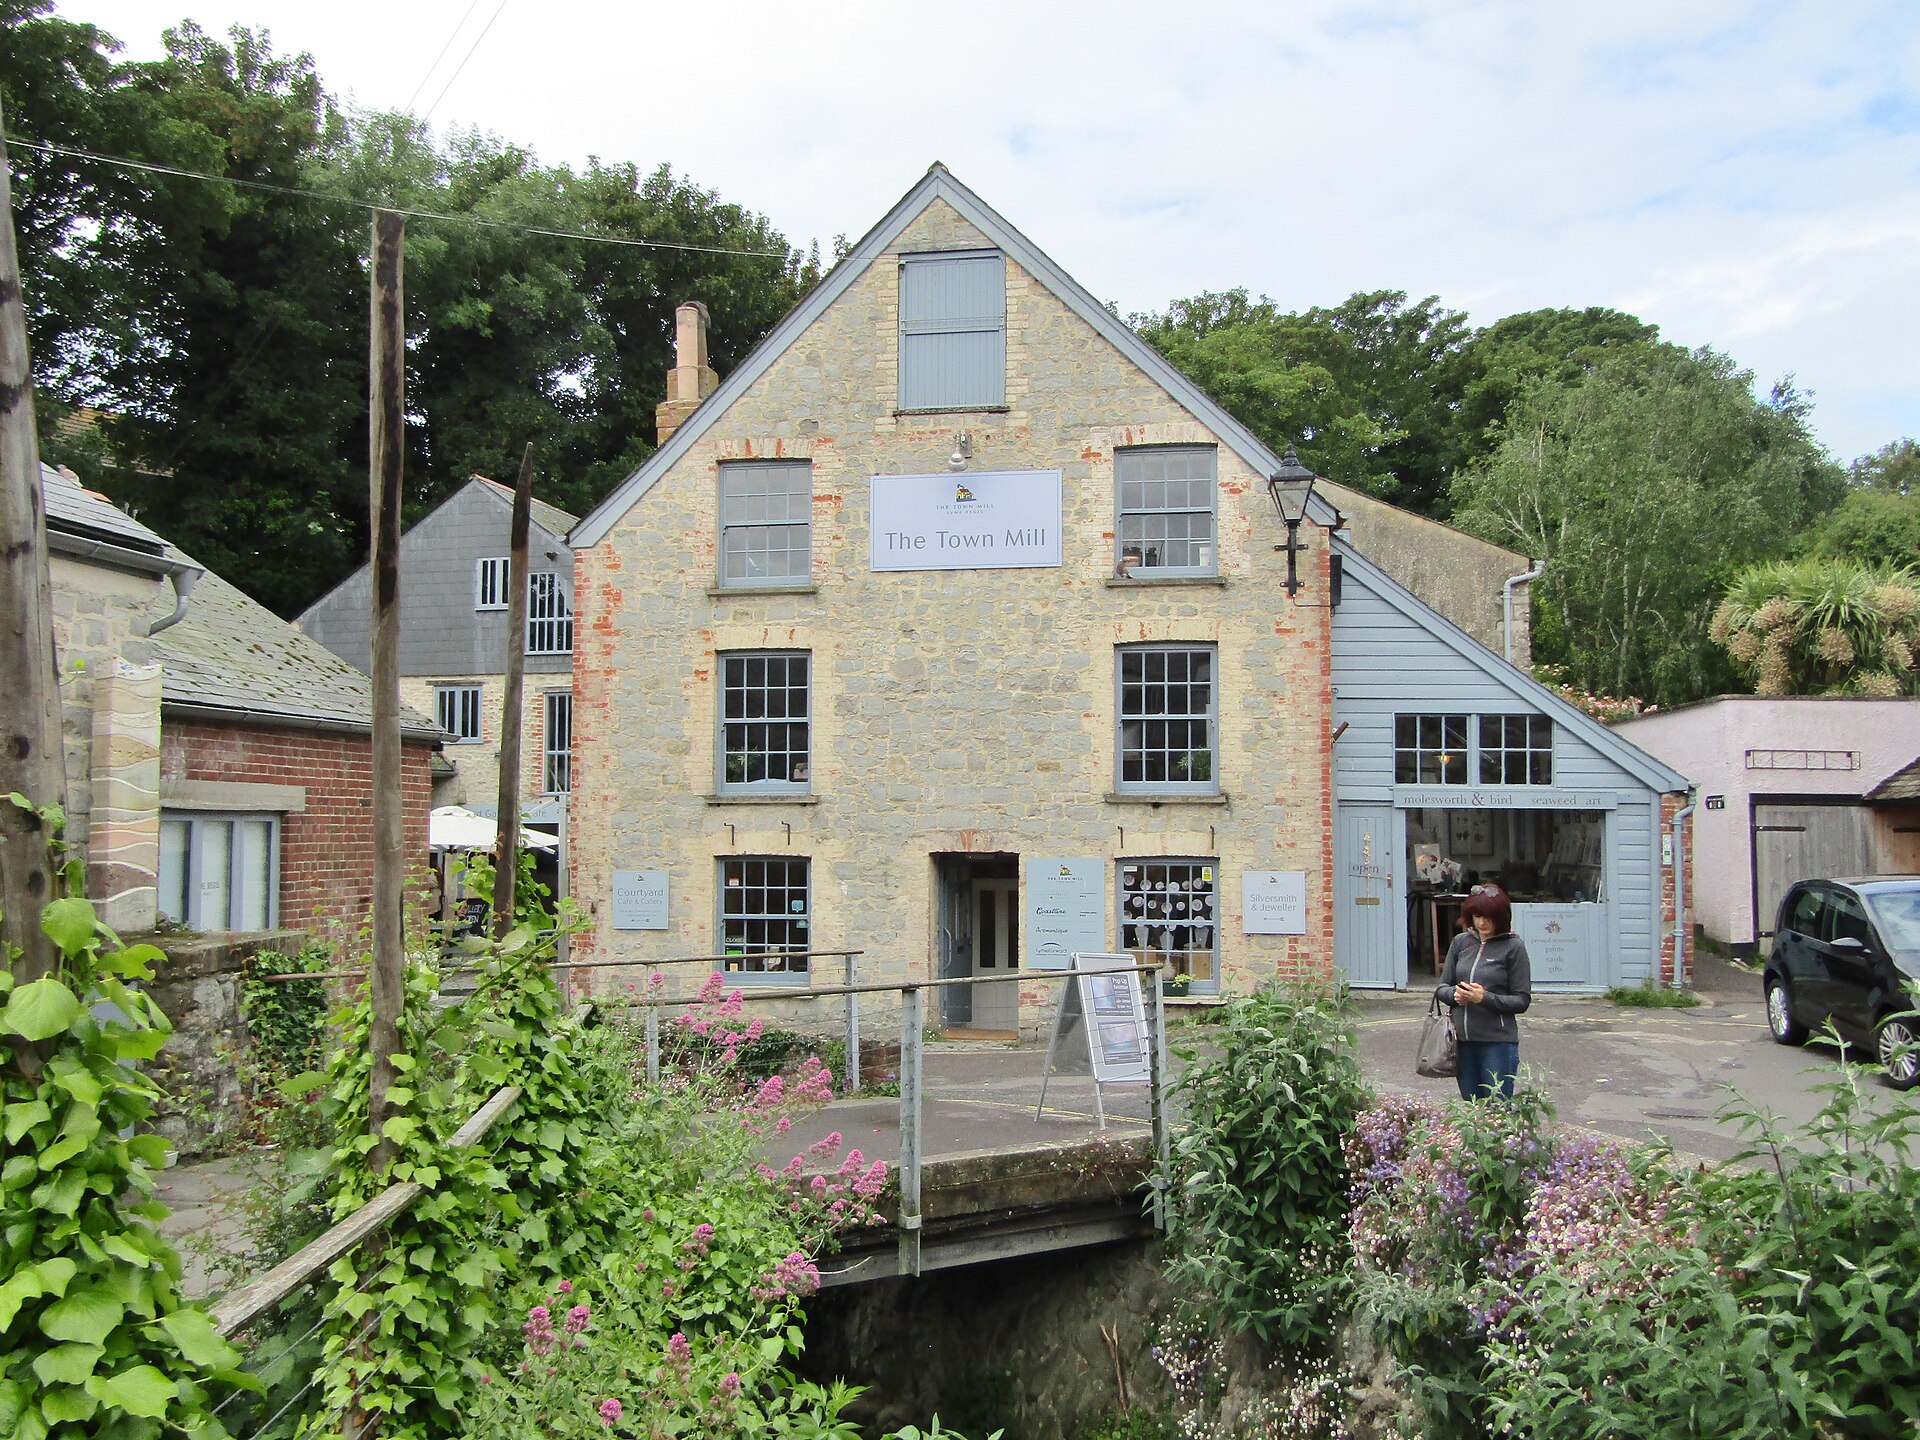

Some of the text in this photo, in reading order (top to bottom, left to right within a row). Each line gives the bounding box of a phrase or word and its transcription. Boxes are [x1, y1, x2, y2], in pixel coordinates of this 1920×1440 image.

[884, 528, 1046, 550] The Town Mill
[1404, 792, 1601, 806] molesworth & bird seaweed art
[617, 888, 664, 897] Courtyard
[1250, 894, 1297, 902] Silversmith
